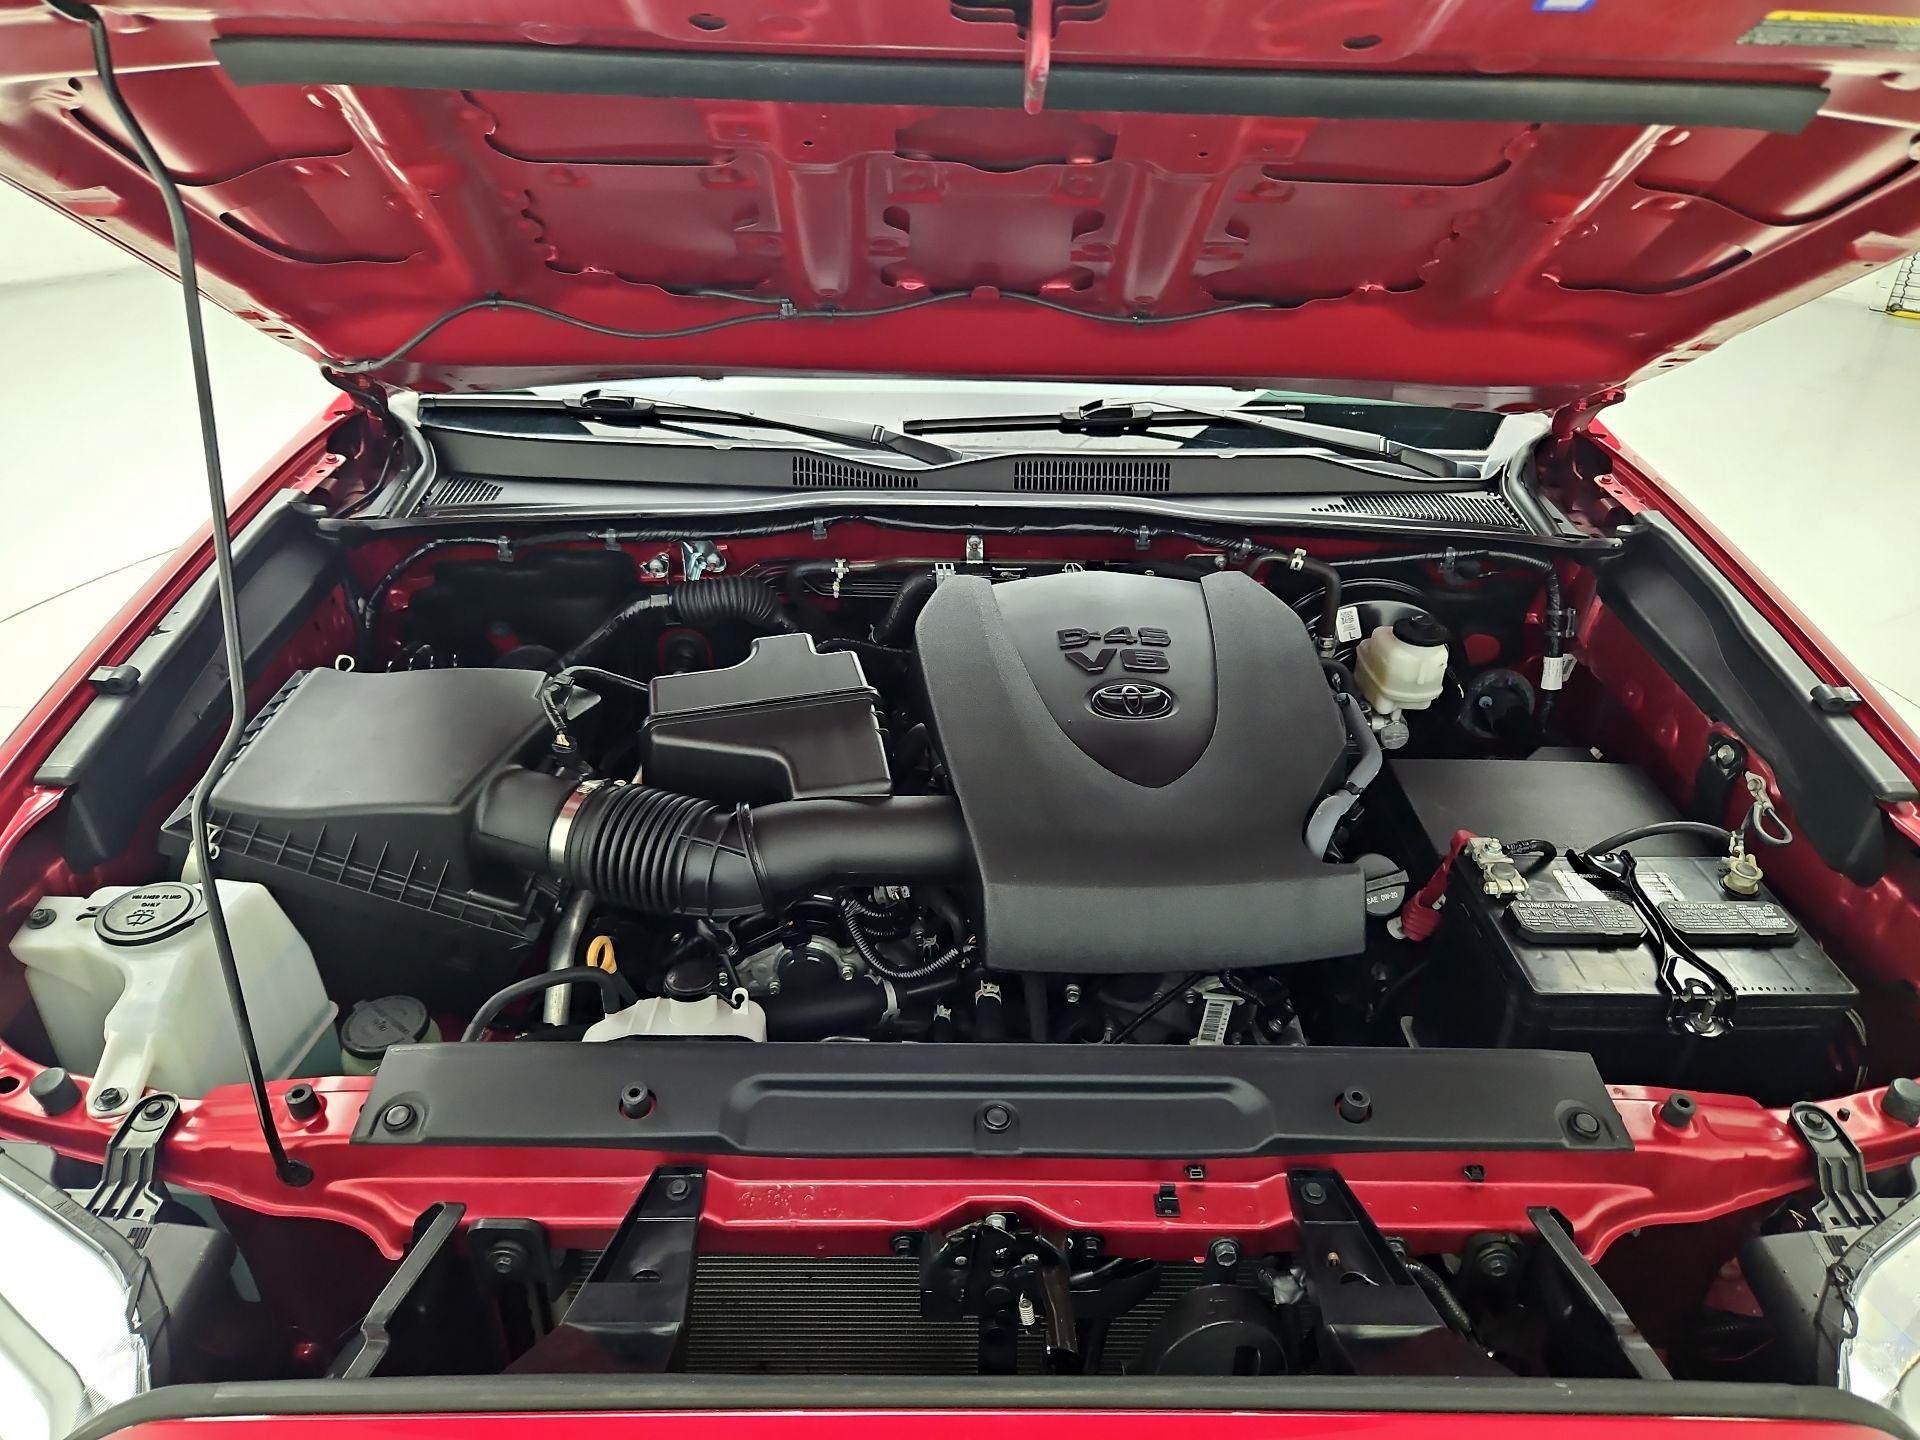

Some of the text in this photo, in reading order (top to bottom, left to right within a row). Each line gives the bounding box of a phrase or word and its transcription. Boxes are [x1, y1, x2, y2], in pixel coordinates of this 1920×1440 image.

[1057, 626, 1171, 649] D-4S
[1065, 648, 1170, 672] V6
[1366, 896, 1378, 904] SAE
